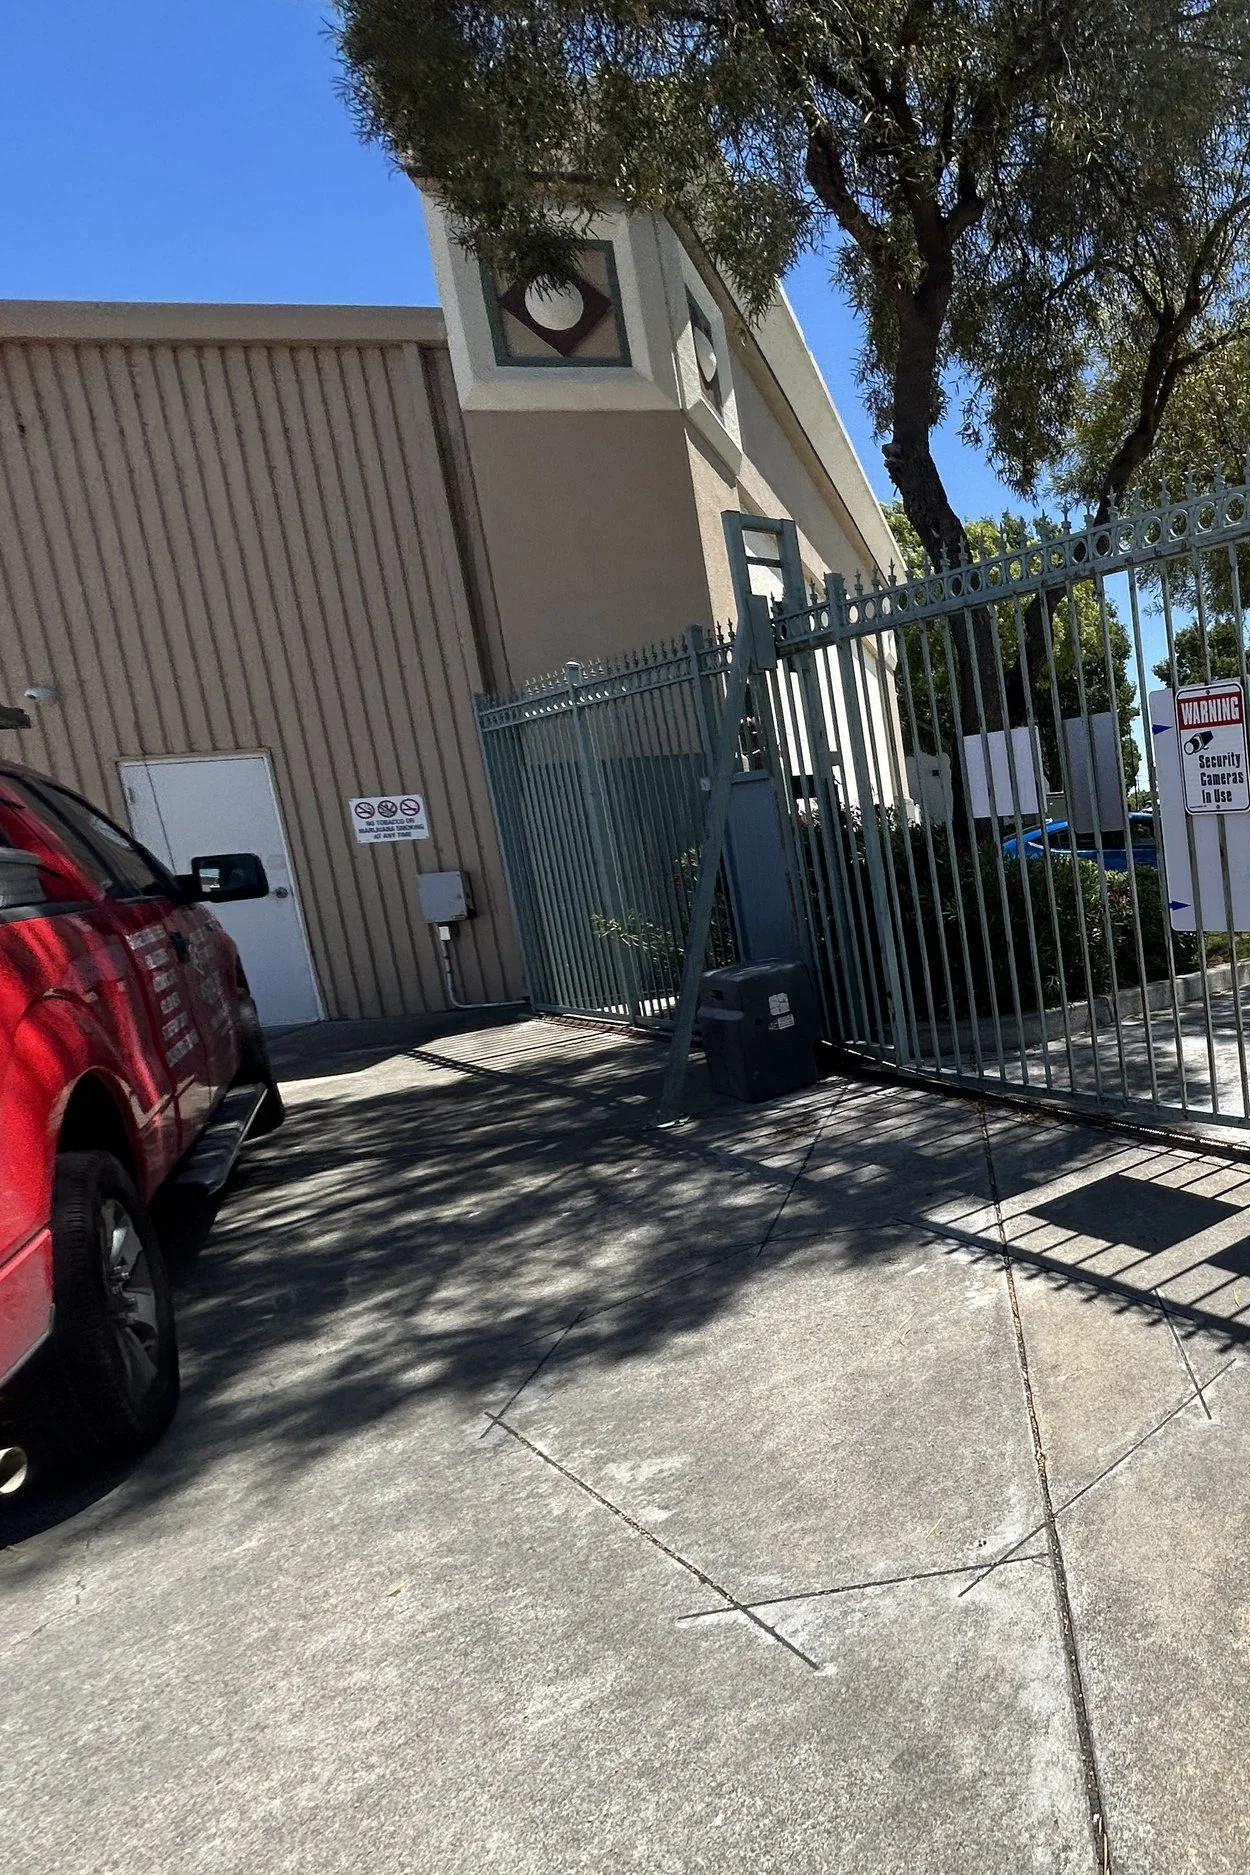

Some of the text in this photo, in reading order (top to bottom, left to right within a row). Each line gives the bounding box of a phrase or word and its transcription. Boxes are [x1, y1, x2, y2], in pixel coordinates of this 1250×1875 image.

[1181, 697, 1240, 725] WARNING
[1199, 752, 1241, 768] Security
[1201, 772, 1244, 786] Cameras
[1202, 788, 1232, 804] In Use
